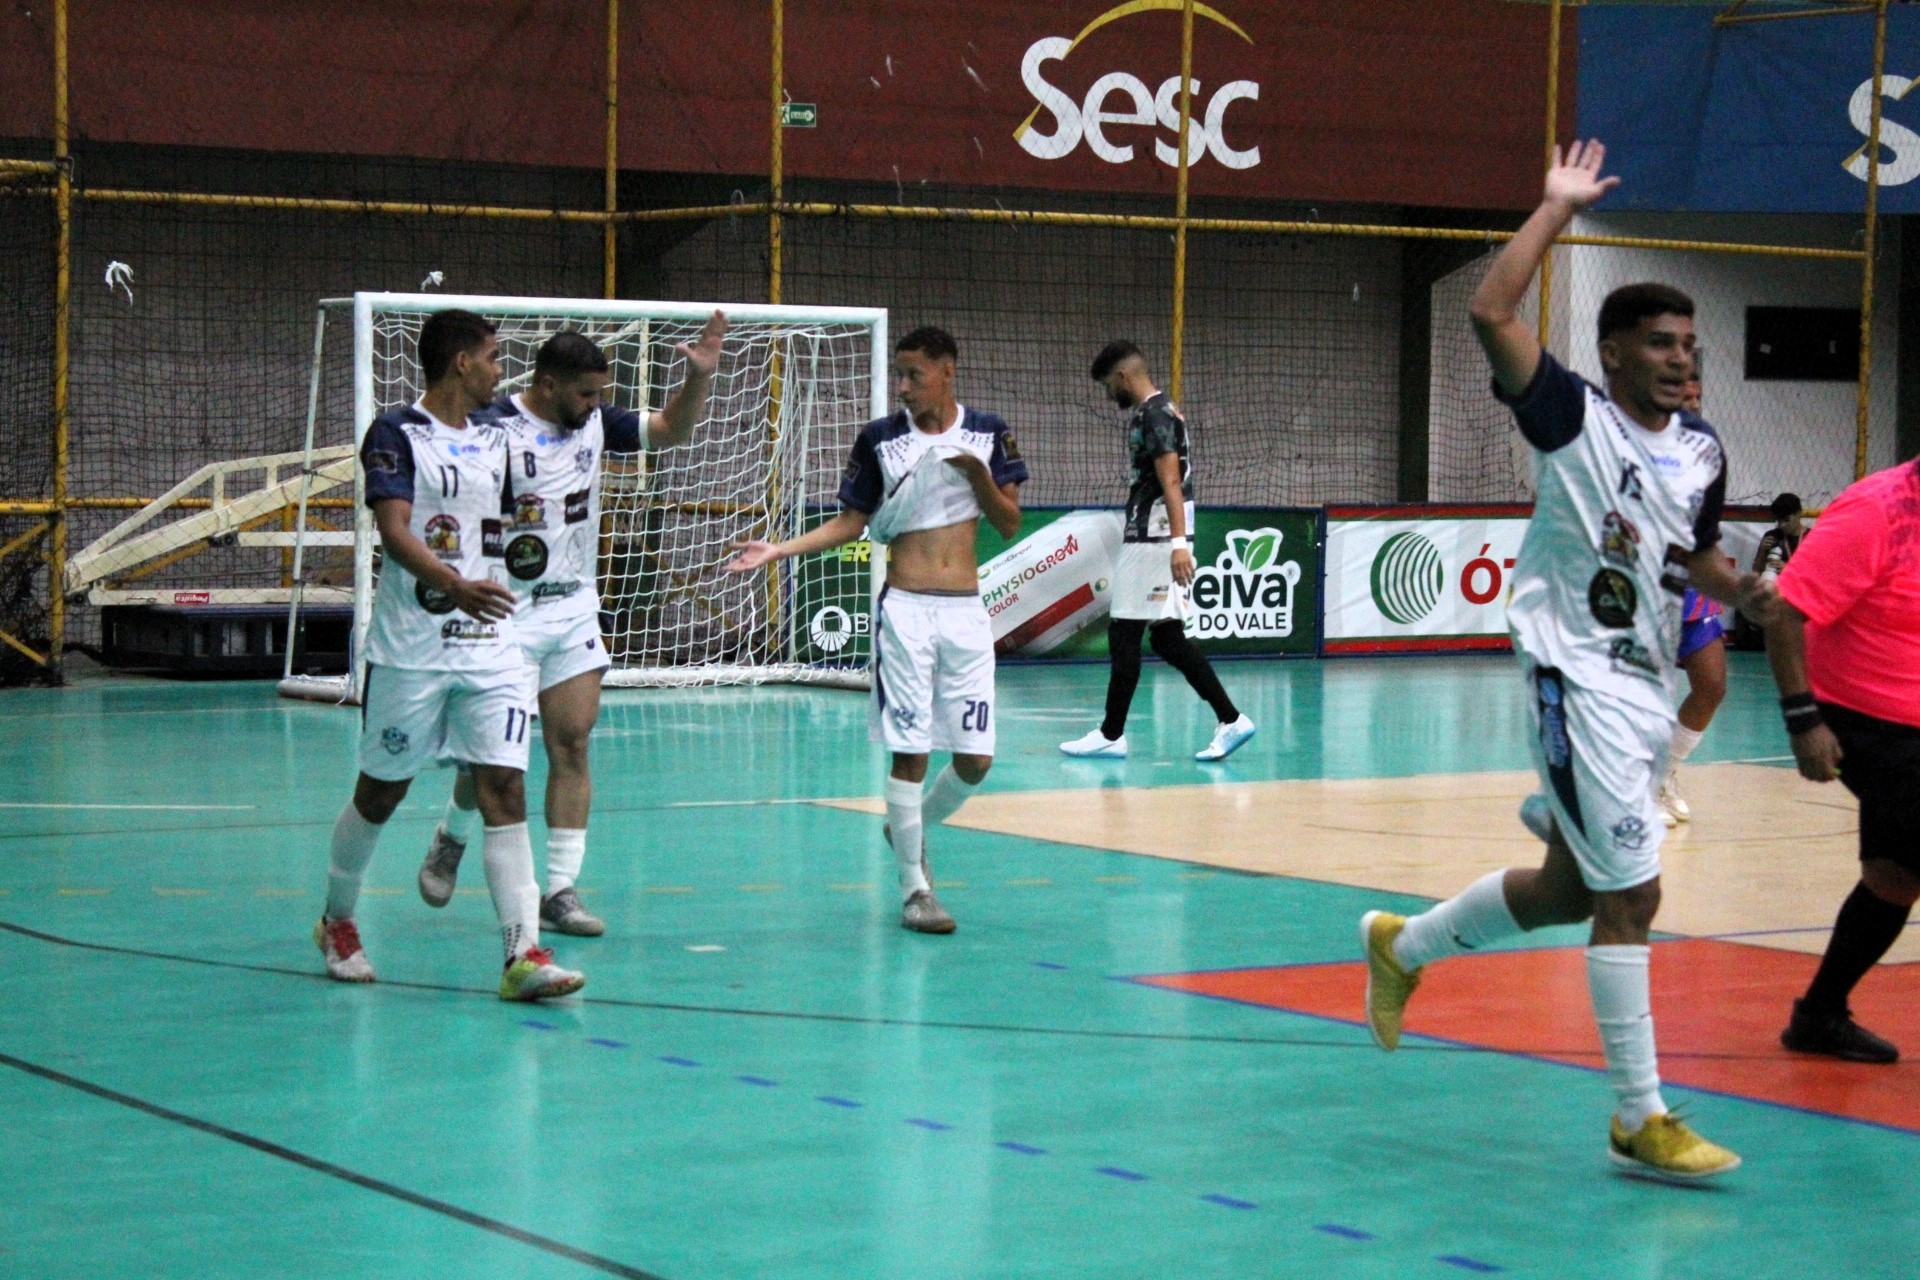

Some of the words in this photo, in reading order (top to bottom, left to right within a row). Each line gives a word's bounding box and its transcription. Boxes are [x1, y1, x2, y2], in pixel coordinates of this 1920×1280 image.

[1015, 36, 1261, 170] Sesc
[439, 464, 459, 498] 17
[523, 450, 537, 478] 8
[982, 534, 1079, 607] PHYSIOGROW
[1187, 558, 1287, 609] eiva
[1461, 543, 1517, 605] Ó
[988, 593, 1019, 617] COLOR
[1200, 613, 1228, 631] DO
[1235, 612, 1286, 630] VALE
[505, 707, 526, 744] 17
[962, 700, 989, 732] 20
